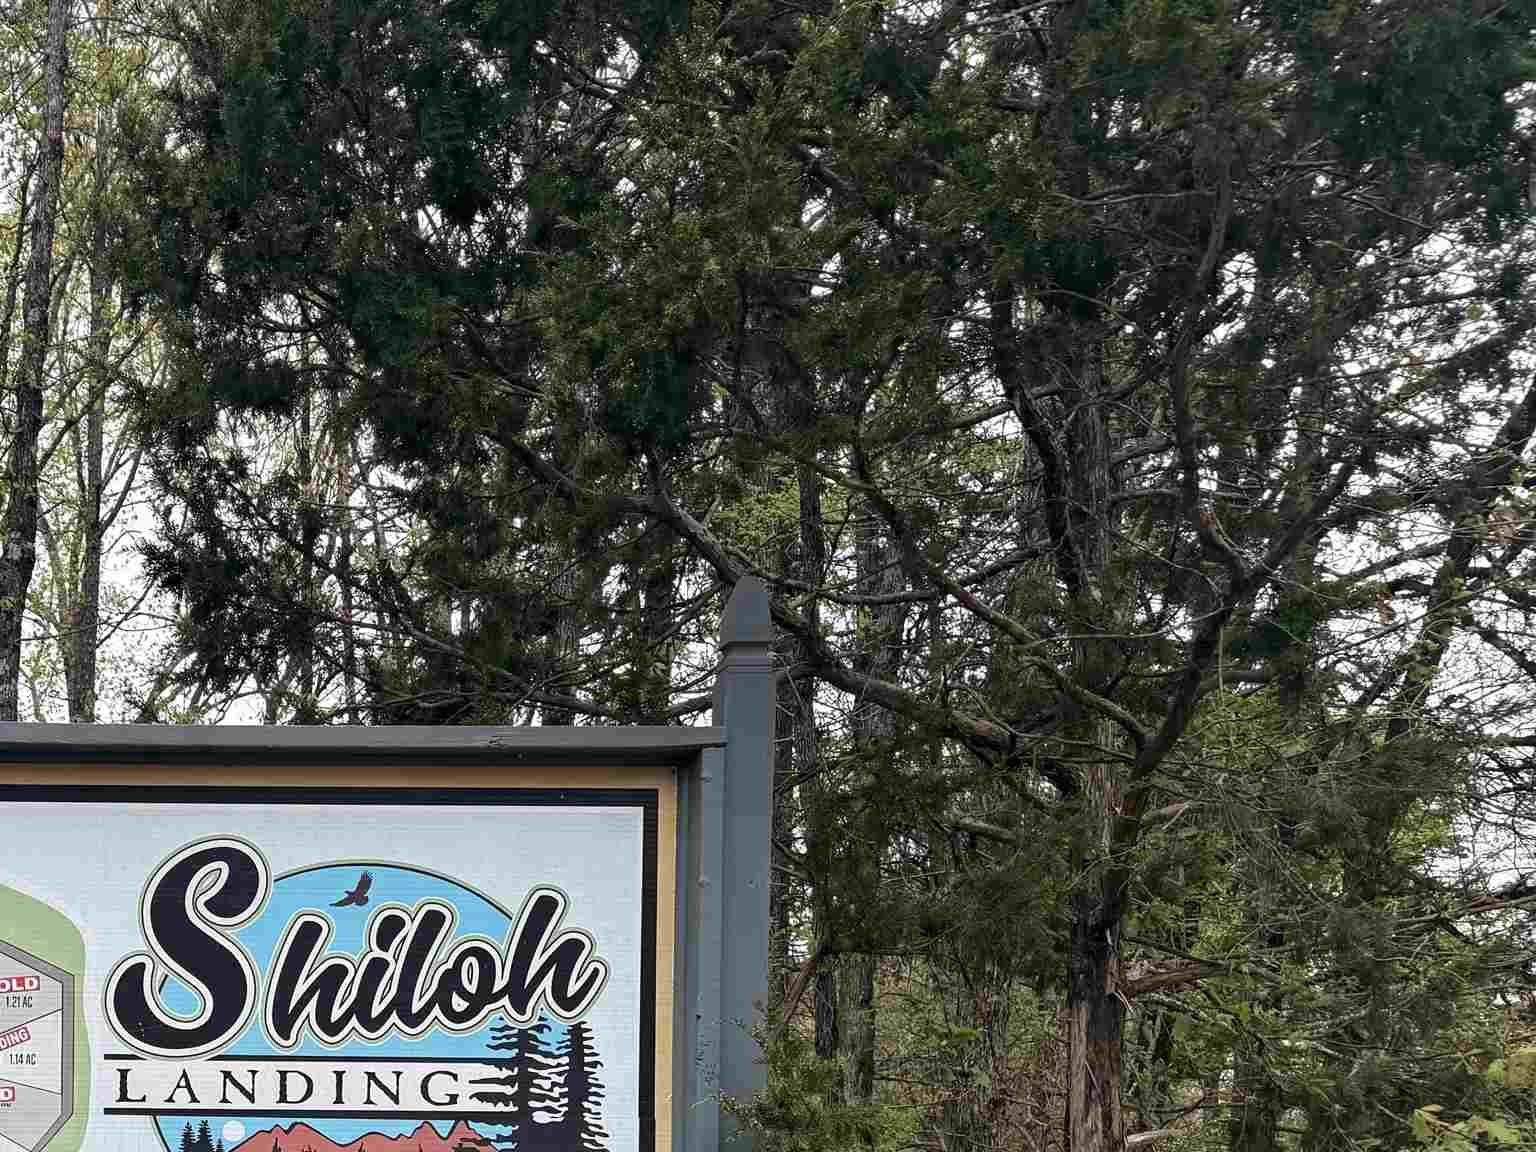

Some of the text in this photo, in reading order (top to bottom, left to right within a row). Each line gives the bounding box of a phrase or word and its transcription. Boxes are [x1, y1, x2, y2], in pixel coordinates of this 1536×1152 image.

[109, 837, 604, 1052] Shiloh
[6, 996, 33, 1008] 1.21 AC
[10, 1054, 23, 1065] 1.14
[26, 1054, 36, 1065] AC
[116, 1068, 460, 1106] LANDING
